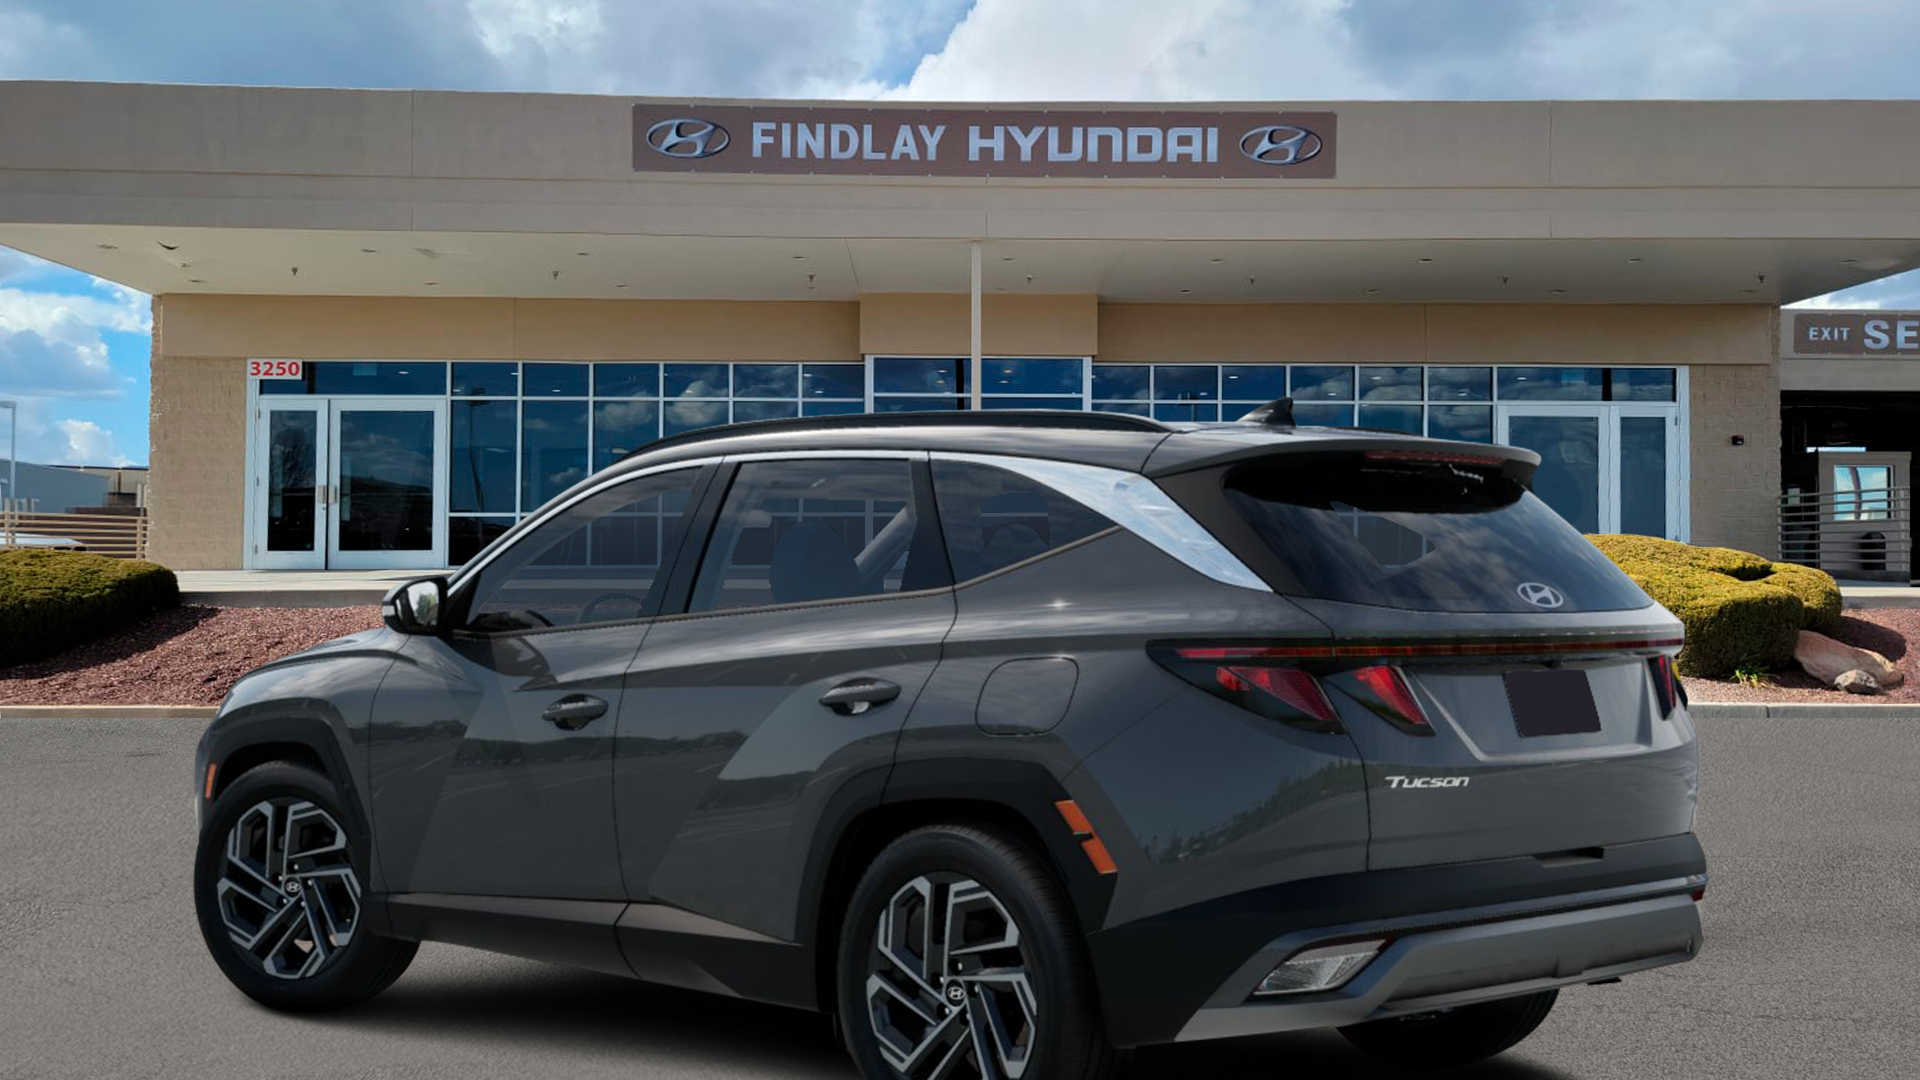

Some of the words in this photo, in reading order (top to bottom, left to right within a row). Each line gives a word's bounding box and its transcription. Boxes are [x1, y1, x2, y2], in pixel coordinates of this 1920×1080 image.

[752, 122, 946, 161] FINDLAY
[968, 125, 1219, 163] HYUNDAI
[1809, 327, 1850, 341] EXIT
[249, 361, 300, 376] 3250
